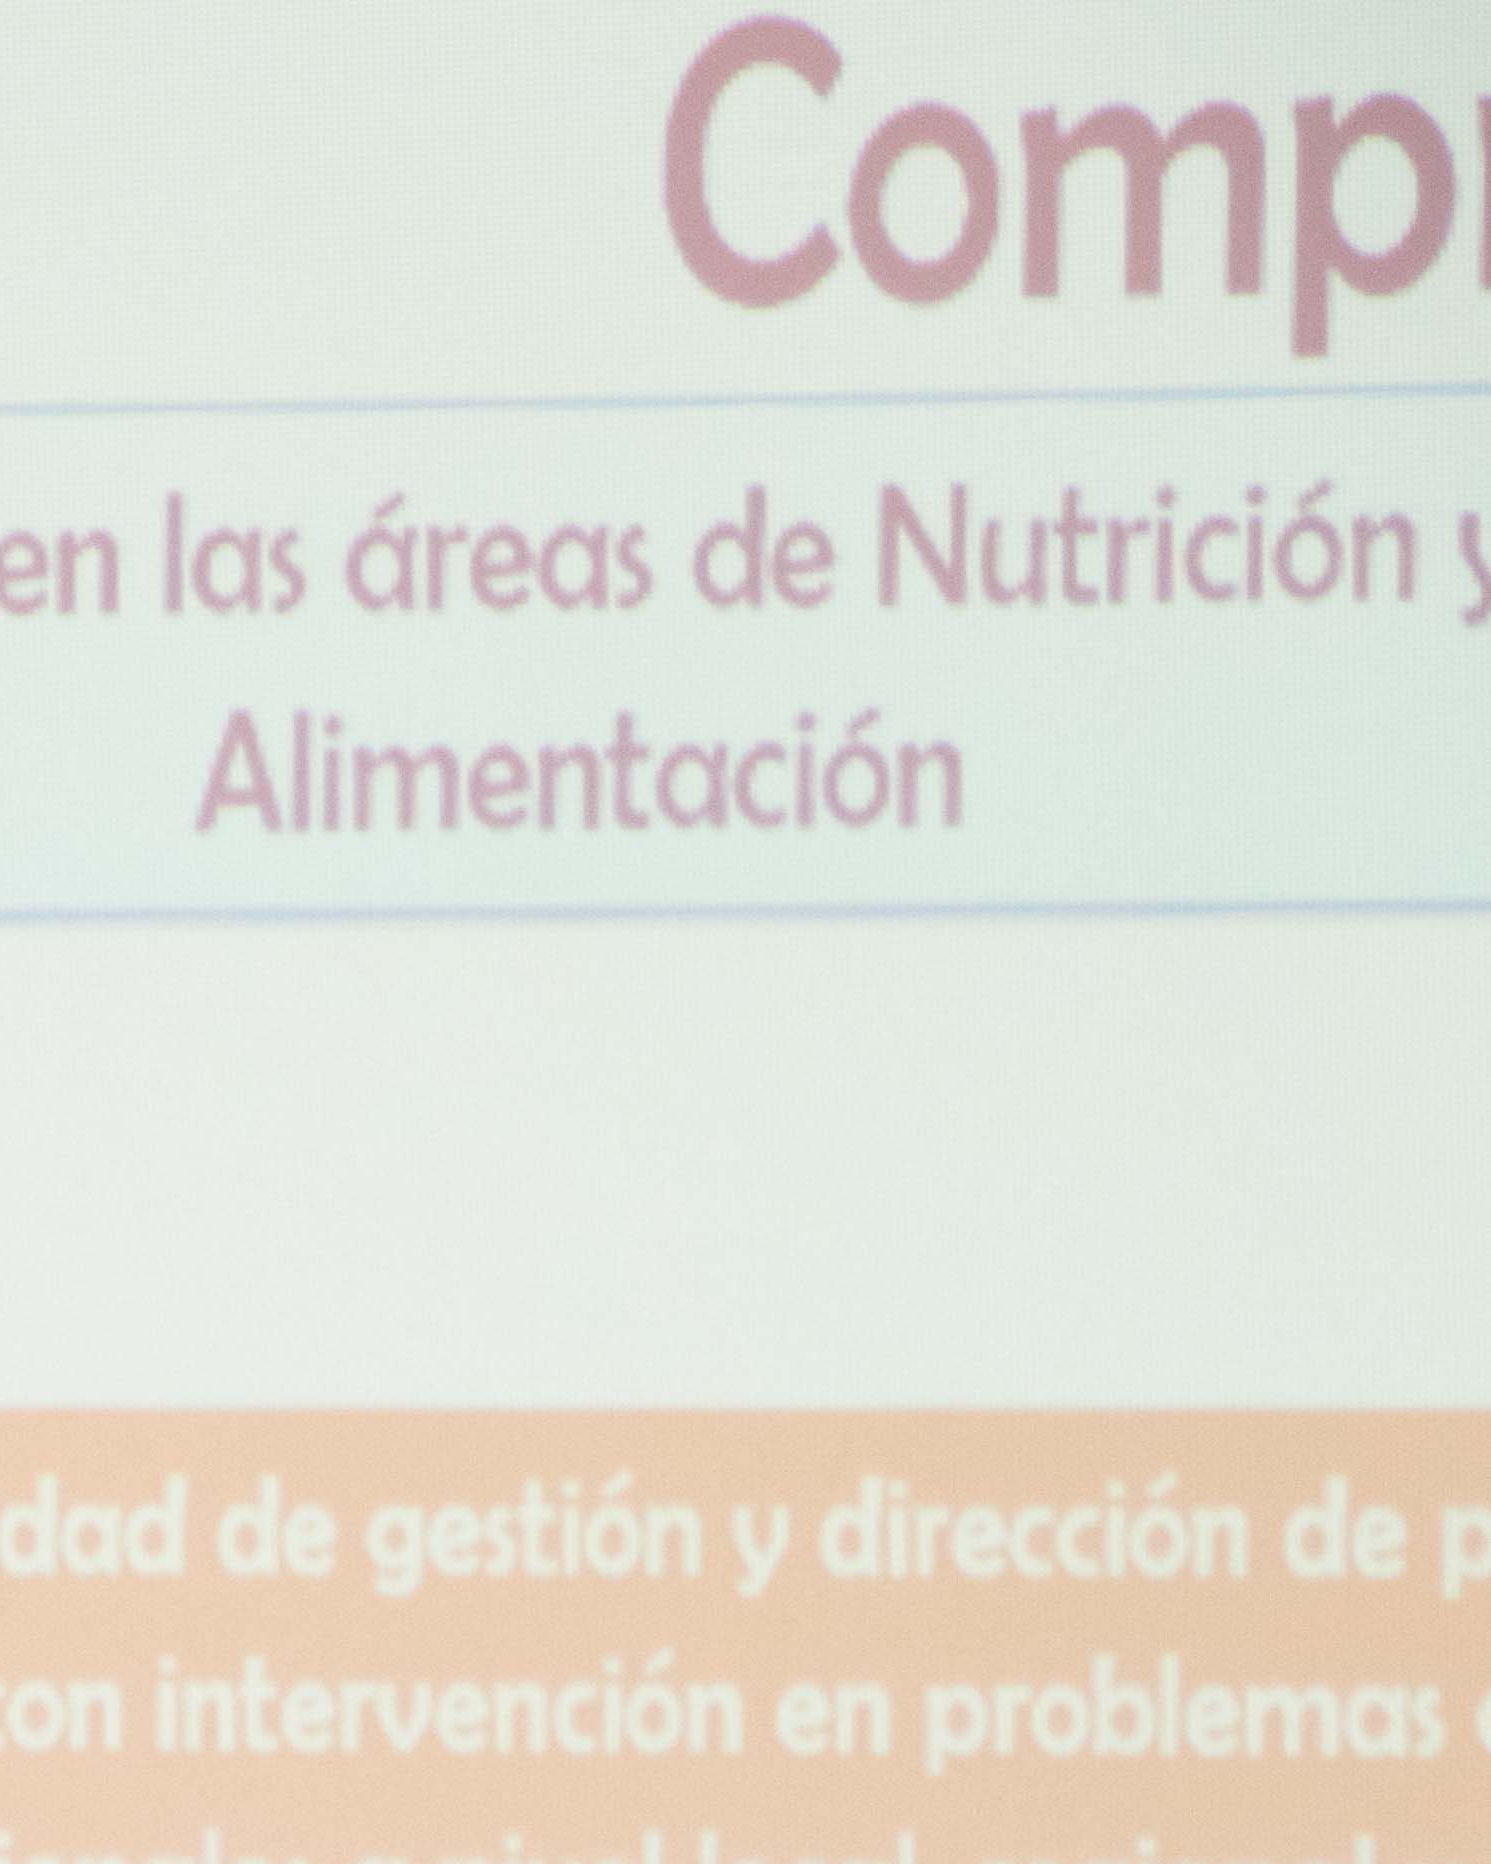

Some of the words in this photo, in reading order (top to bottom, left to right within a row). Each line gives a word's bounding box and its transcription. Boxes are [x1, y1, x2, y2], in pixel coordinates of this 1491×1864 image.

[664, 14, 1491, 358] Comp
[163, 492, 307, 615] las
[344, 493, 654, 613] áreas
[692, 484, 836, 610] de
[878, 479, 1420, 607] Nutrición
[194, 706, 964, 834] Alimentación
[218, 1475, 337, 1577] de
[367, 1467, 703, 1597] gestión
[734, 1500, 791, 1597] y
[820, 1468, 1252, 1582] dirección
[1282, 1472, 1407, 1580] de
[155, 1650, 743, 1755] intervención
[775, 1684, 891, 1755] en
[926, 1652, 1445, 1776] problemas
